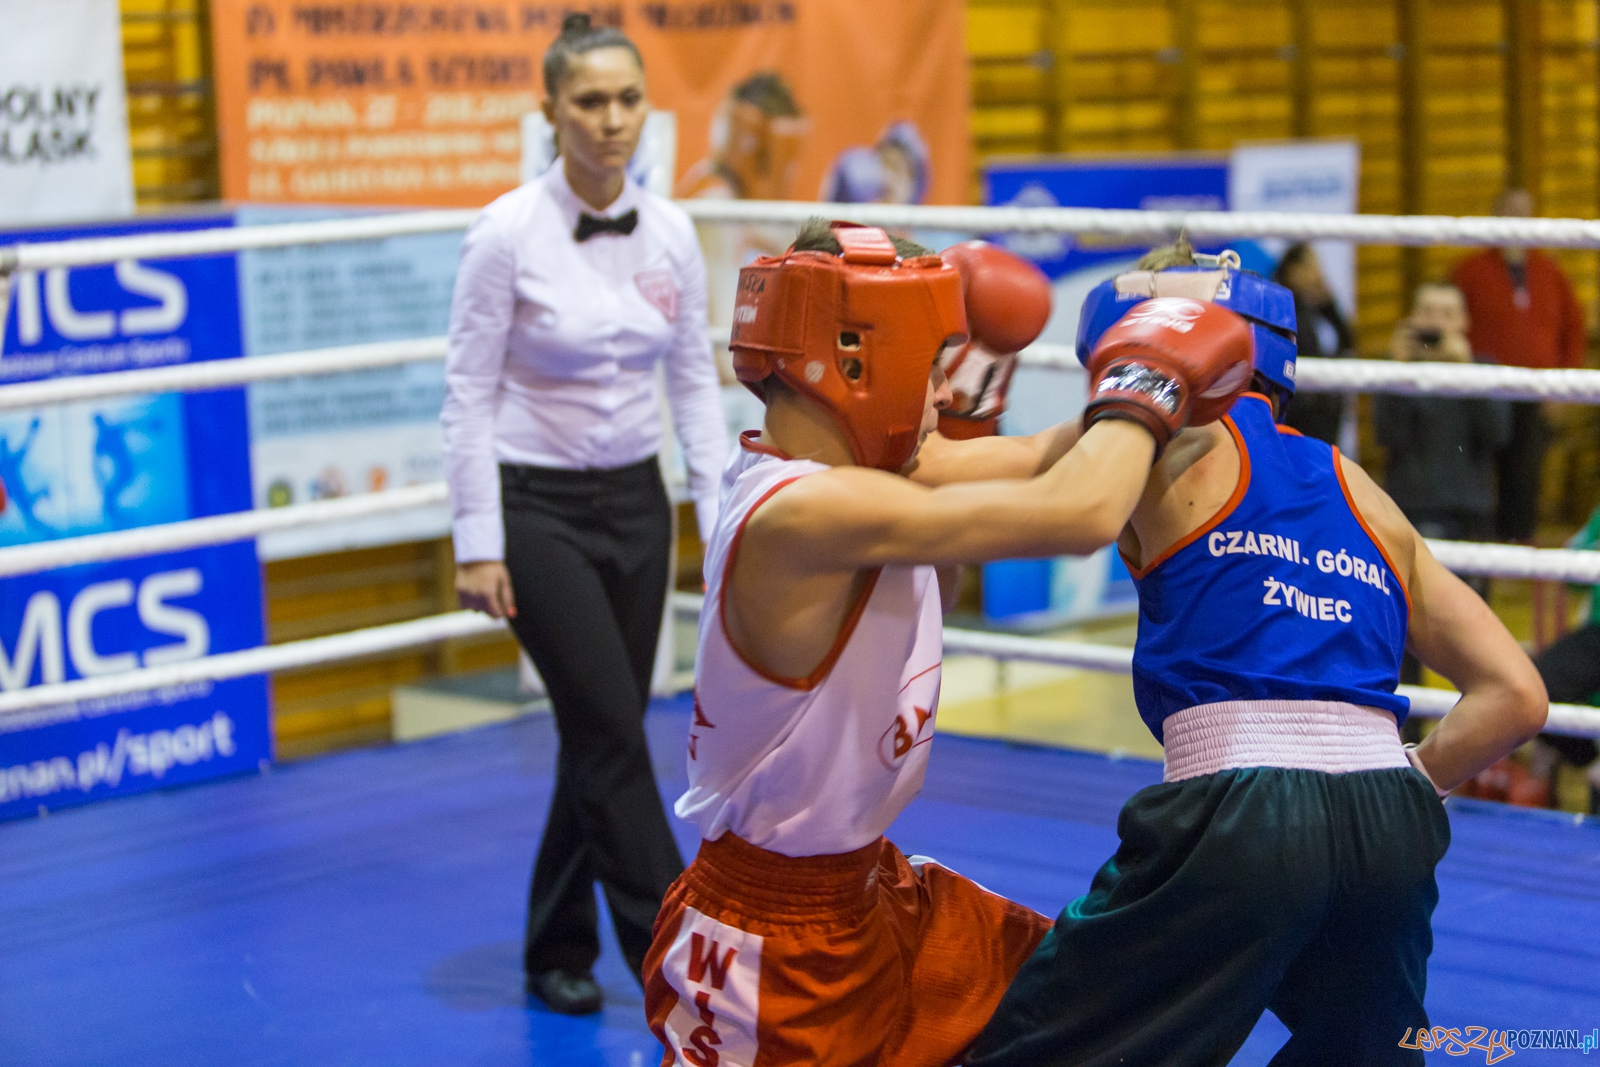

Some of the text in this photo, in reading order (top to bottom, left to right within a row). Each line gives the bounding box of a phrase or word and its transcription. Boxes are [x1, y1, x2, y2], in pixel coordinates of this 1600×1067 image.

[0, 83, 101, 121] OLNY
[0, 126, 96, 168] LĄSK
[1316, 548, 1390, 596] GÓRAL
[1263, 576, 1352, 623] ŻYWIEC
